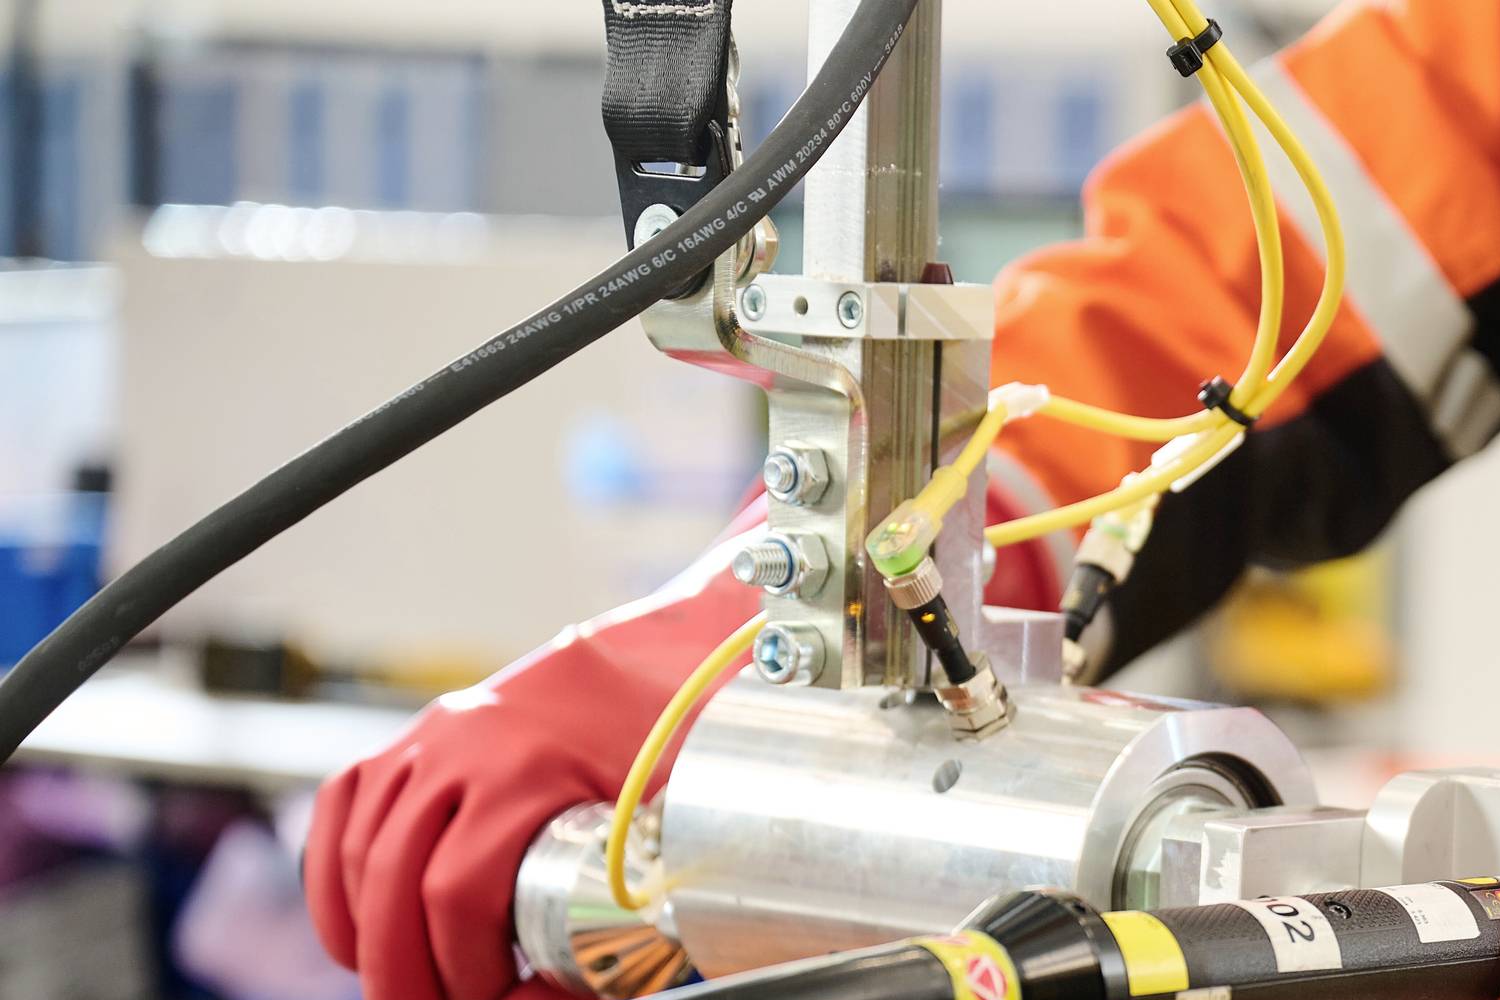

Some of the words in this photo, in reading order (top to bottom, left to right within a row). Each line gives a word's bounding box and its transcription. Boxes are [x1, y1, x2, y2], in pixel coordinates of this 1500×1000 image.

[505, 311, 562, 344] 24AWG
[562, 292, 600, 316] 1/PR
[598, 263, 651, 299] 24AWG
[651, 249, 677, 269] 6/C
[676, 217, 726, 253] 16AWG
[725, 200, 748, 222] 4/C
[765, 159, 798, 191] AWM
[795, 127, 828, 164] 20234
[850, 71, 873, 103] 600V
